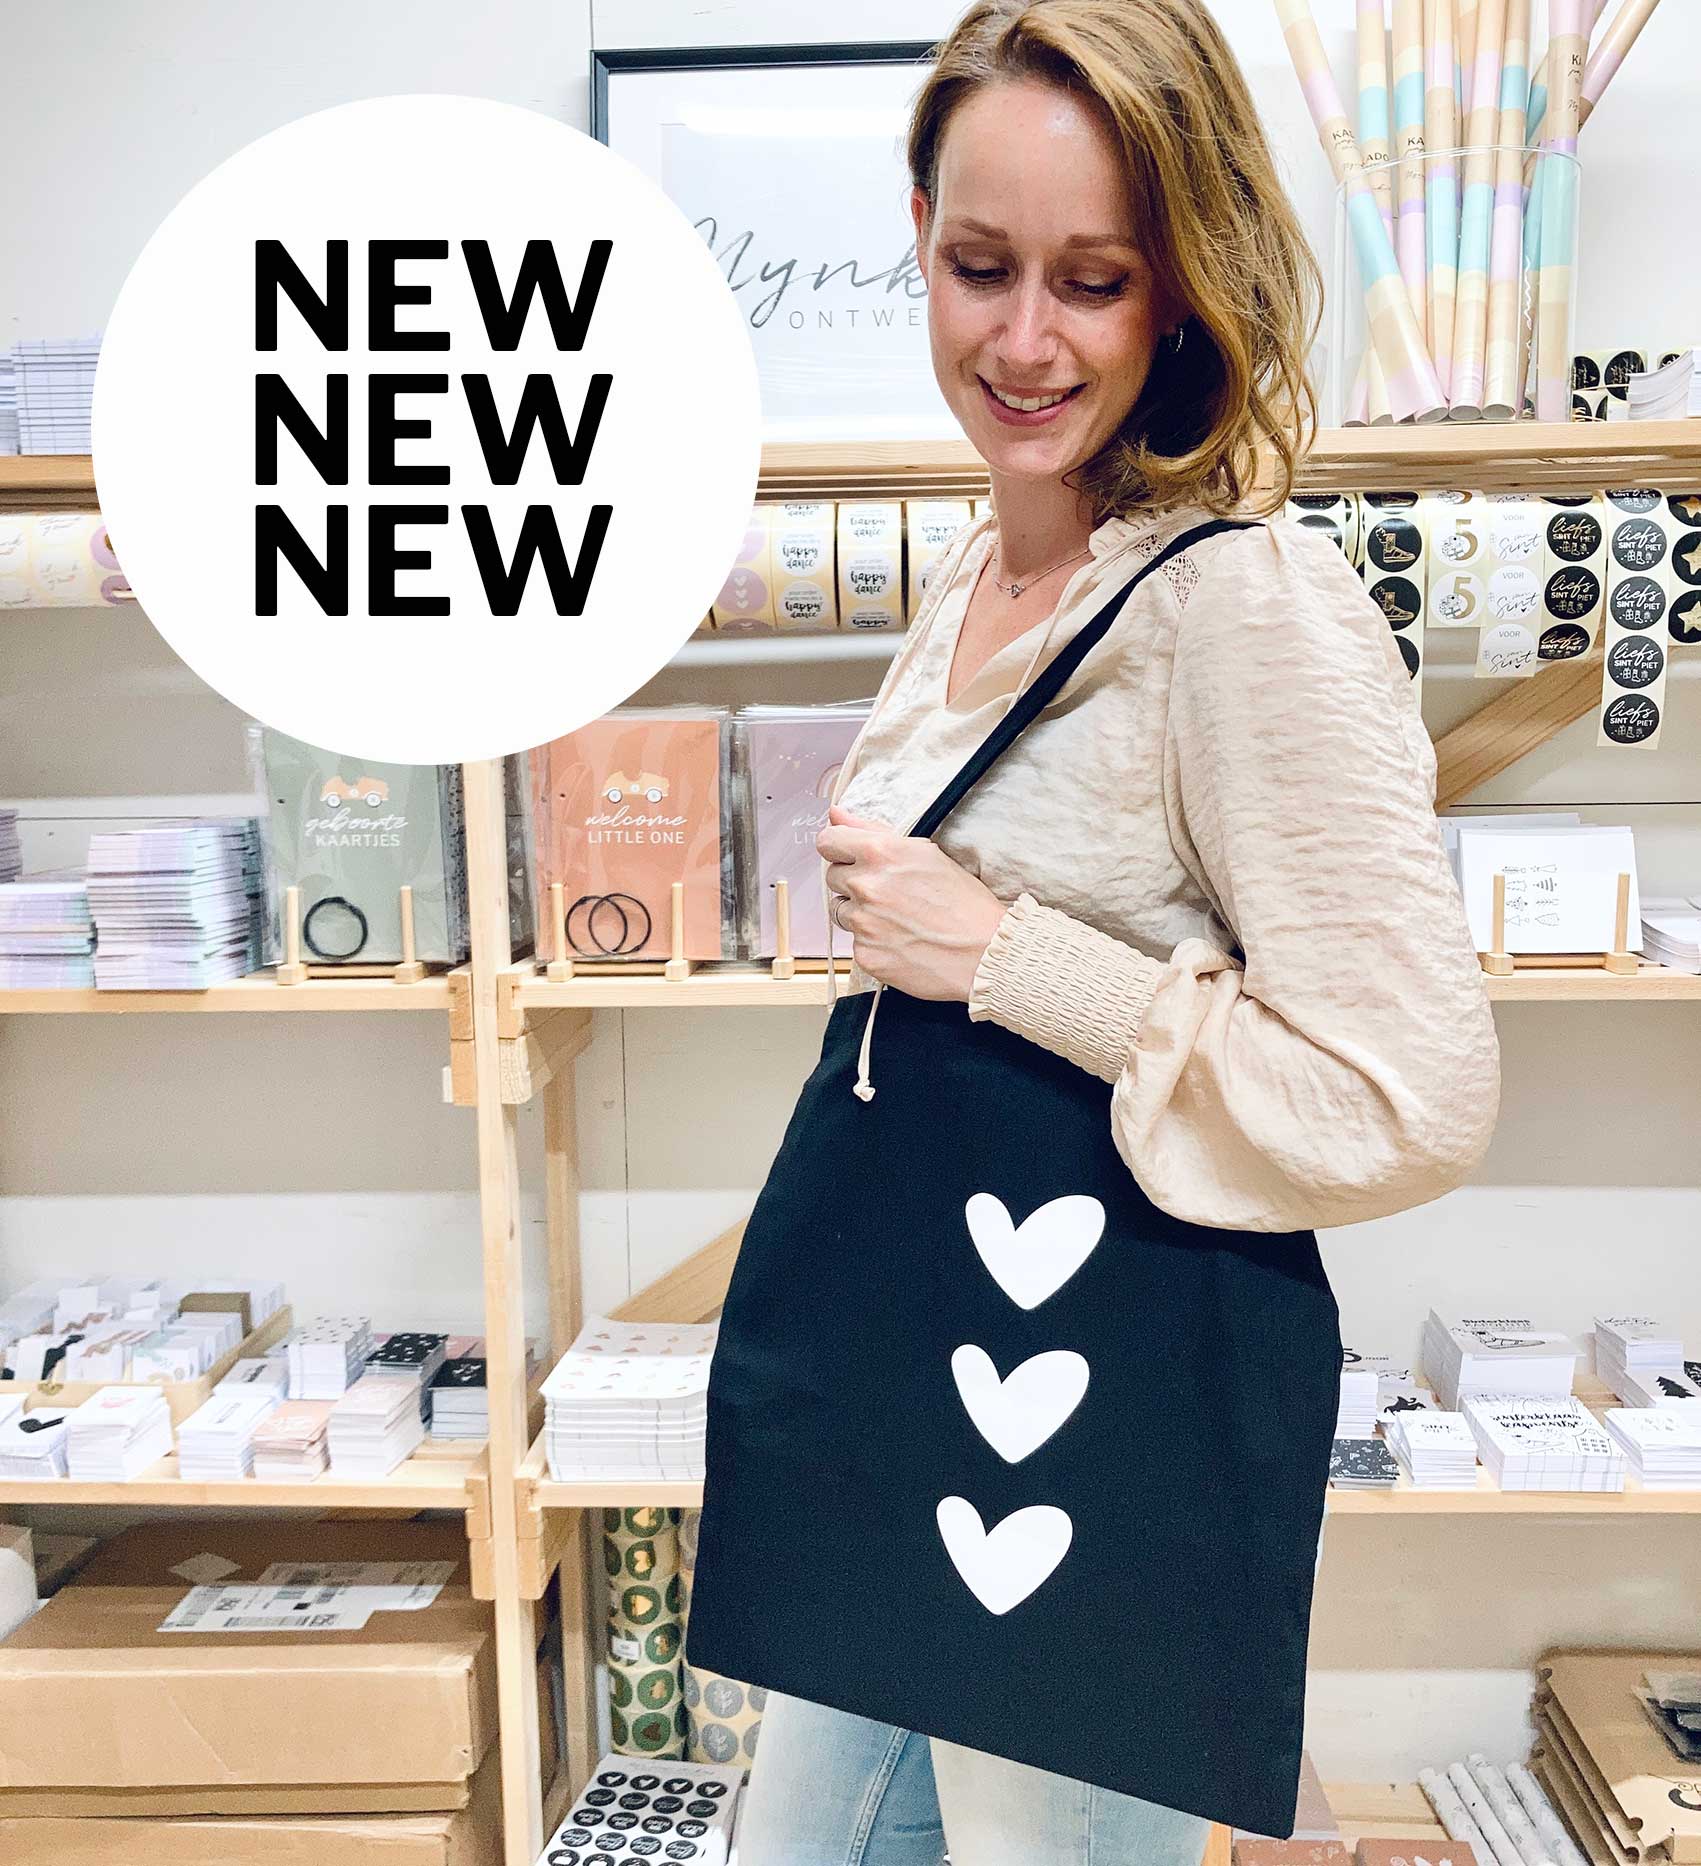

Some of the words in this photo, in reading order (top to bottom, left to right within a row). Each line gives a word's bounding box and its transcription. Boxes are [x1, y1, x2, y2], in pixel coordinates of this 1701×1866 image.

[788, 307, 921, 329] ONTWE
[1455, 518, 1478, 560] 5
[1552, 516, 1596, 540] liefs
[1579, 535, 1596, 543] PIET
[1616, 524, 1662, 549] liefs
[1617, 541, 1636, 549] SINT
[1645, 543, 1662, 551] PIET
[850, 570, 887, 585] happy
[1550, 574, 1595, 599] liefs
[1454, 576, 1476, 619] 5
[1551, 591, 1569, 599] SINT
[1615, 583, 1662, 608] liefs
[1616, 600, 1635, 608] SINT
[1643, 602, 1661, 610] PIET
[1613, 642, 1659, 667] liefs
[1641, 661, 1659, 669] PIET
[1609, 700, 1656, 724] liefs
[1636, 719, 1654, 727] PIET
[585, 804, 688, 827] welcome
[315, 833, 401, 848] KAARTJES
[588, 830, 643, 844] LITTLE
[650, 831, 685, 844] ONE
